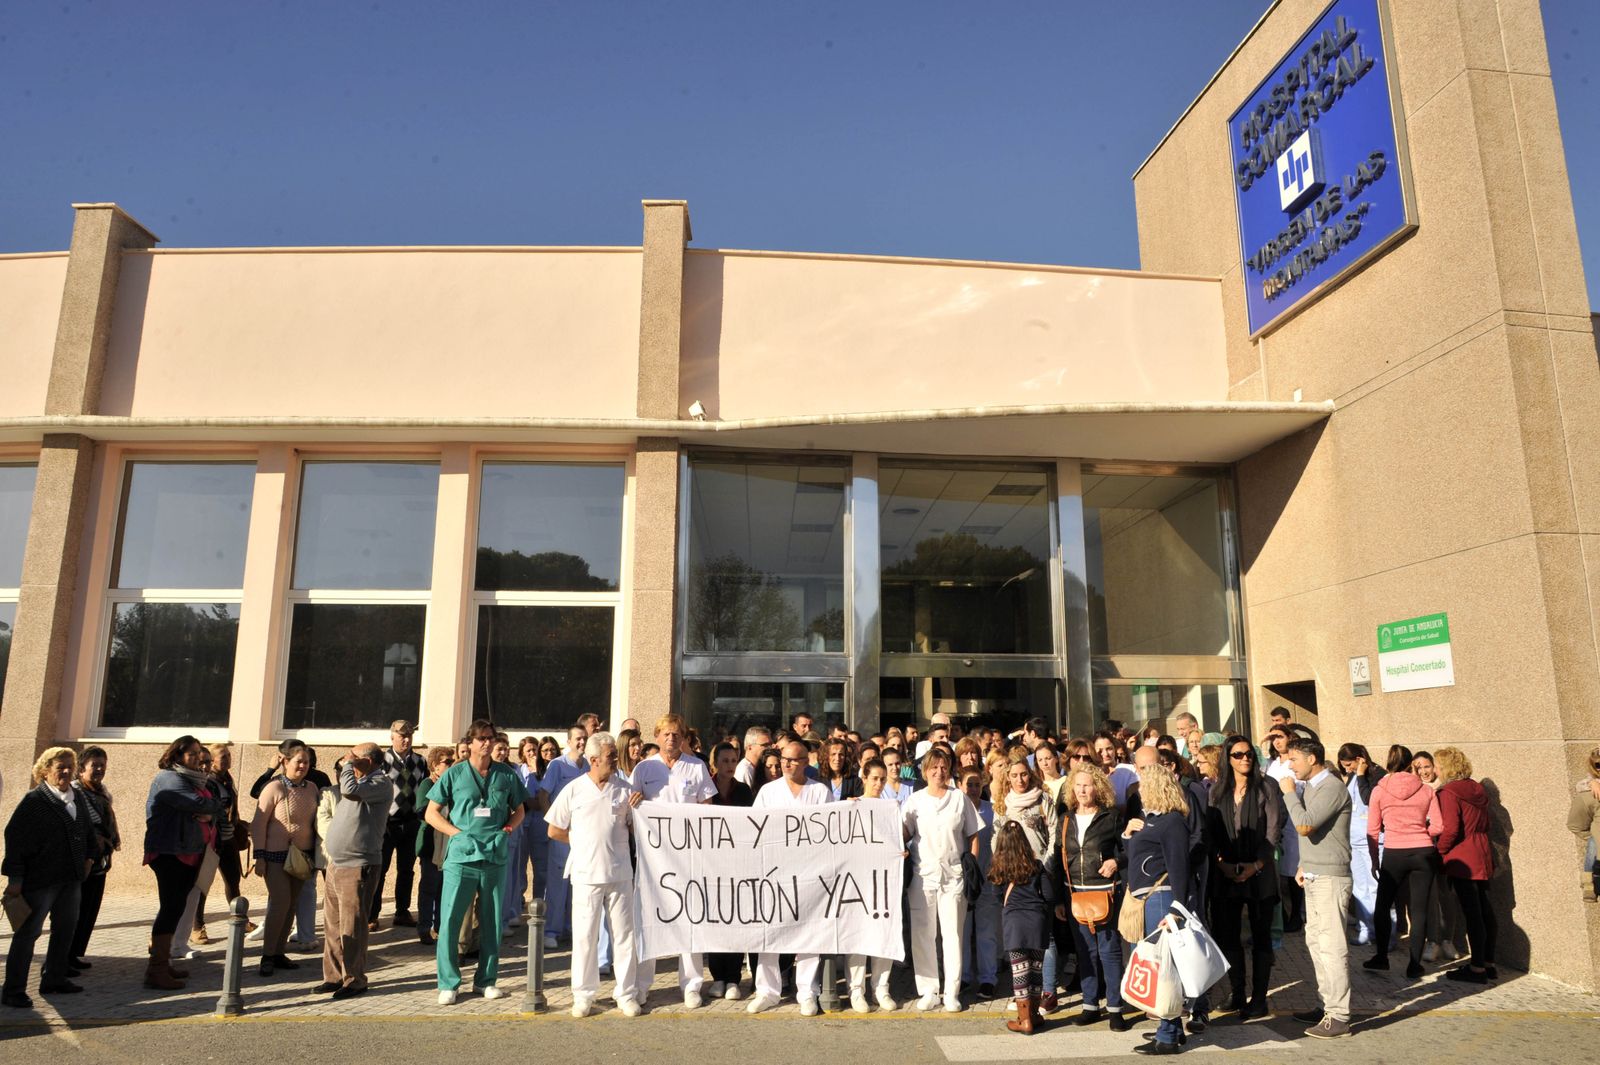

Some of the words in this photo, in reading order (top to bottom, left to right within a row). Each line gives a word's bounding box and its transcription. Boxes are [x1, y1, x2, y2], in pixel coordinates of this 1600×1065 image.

[1240, 15, 1358, 152] HOSPITAL
[1236, 42, 1374, 192] COMARCAL
[1314, 185, 1343, 225] DE
[1343, 150, 1387, 202] LAS
[1393, 625, 1408, 636] JUNTA
[1408, 623, 1416, 633] DE
[1386, 664, 1410, 677] Hospital
[1410, 659, 1446, 672] Concertado
[648, 816, 735, 850] JUNTA
[747, 814, 769, 849] Y
[785, 809, 884, 847] PASCUAL
[656, 866, 799, 925] SOLUCIÓN
[818, 869, 890, 920] YA!!
